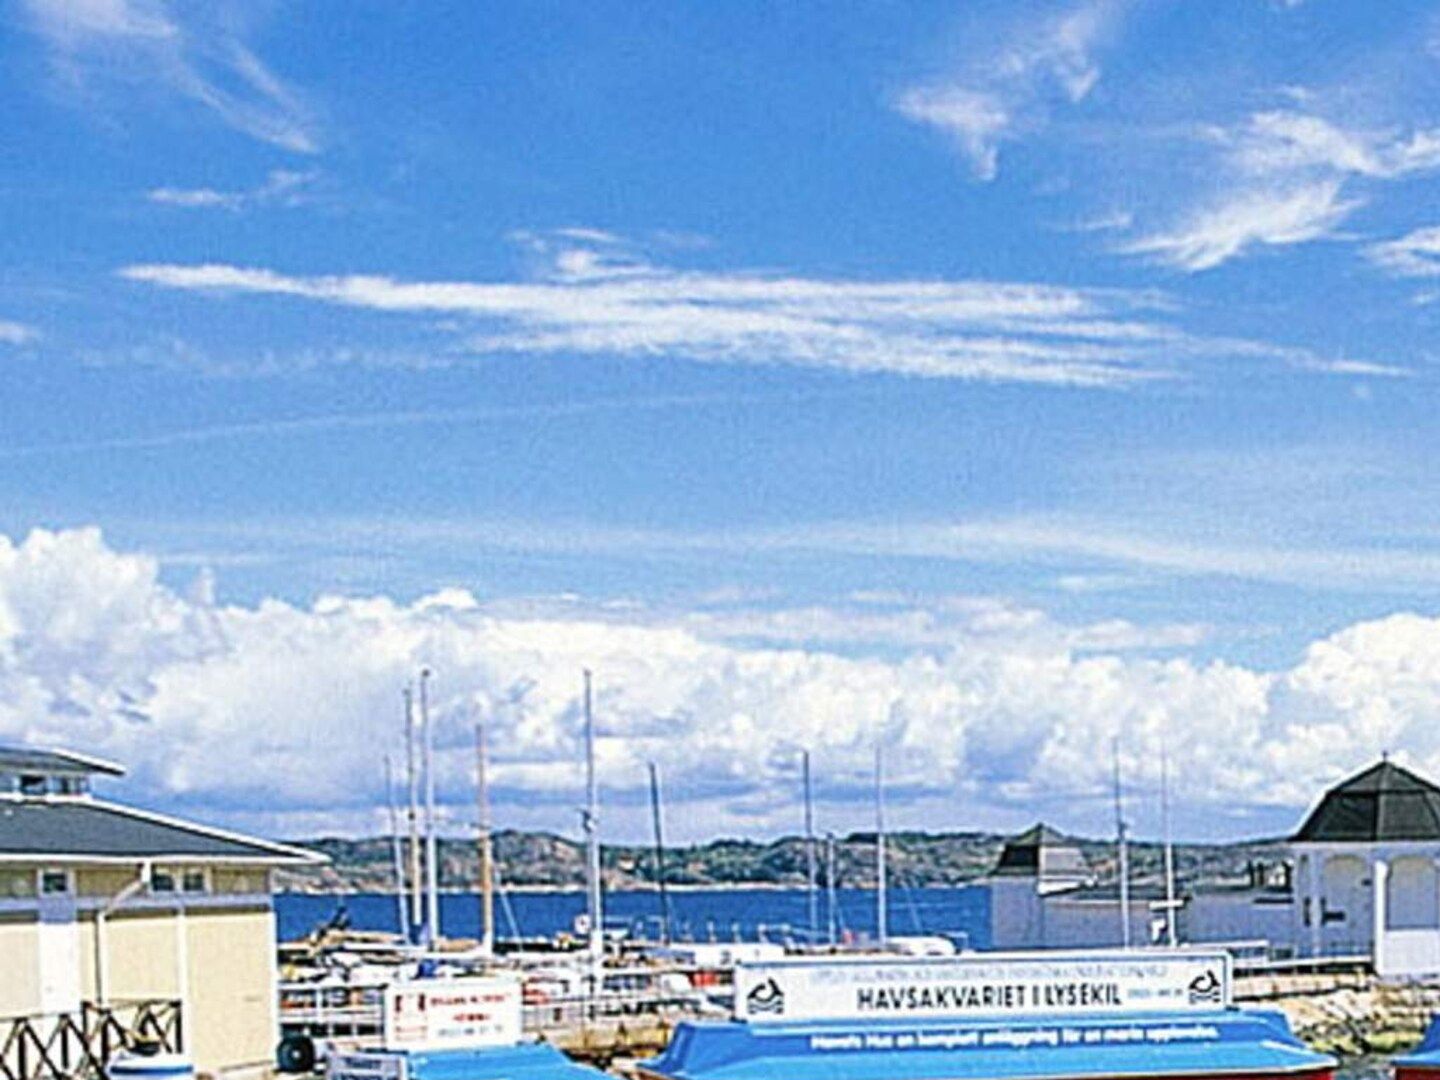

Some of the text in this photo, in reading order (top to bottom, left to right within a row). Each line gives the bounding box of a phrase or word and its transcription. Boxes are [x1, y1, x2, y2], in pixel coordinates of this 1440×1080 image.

[856, 983, 1025, 1010] HAVSAKVARIET
[1032, 984, 1040, 1006] I
[1044, 982, 1122, 1006] LYSEKIL
